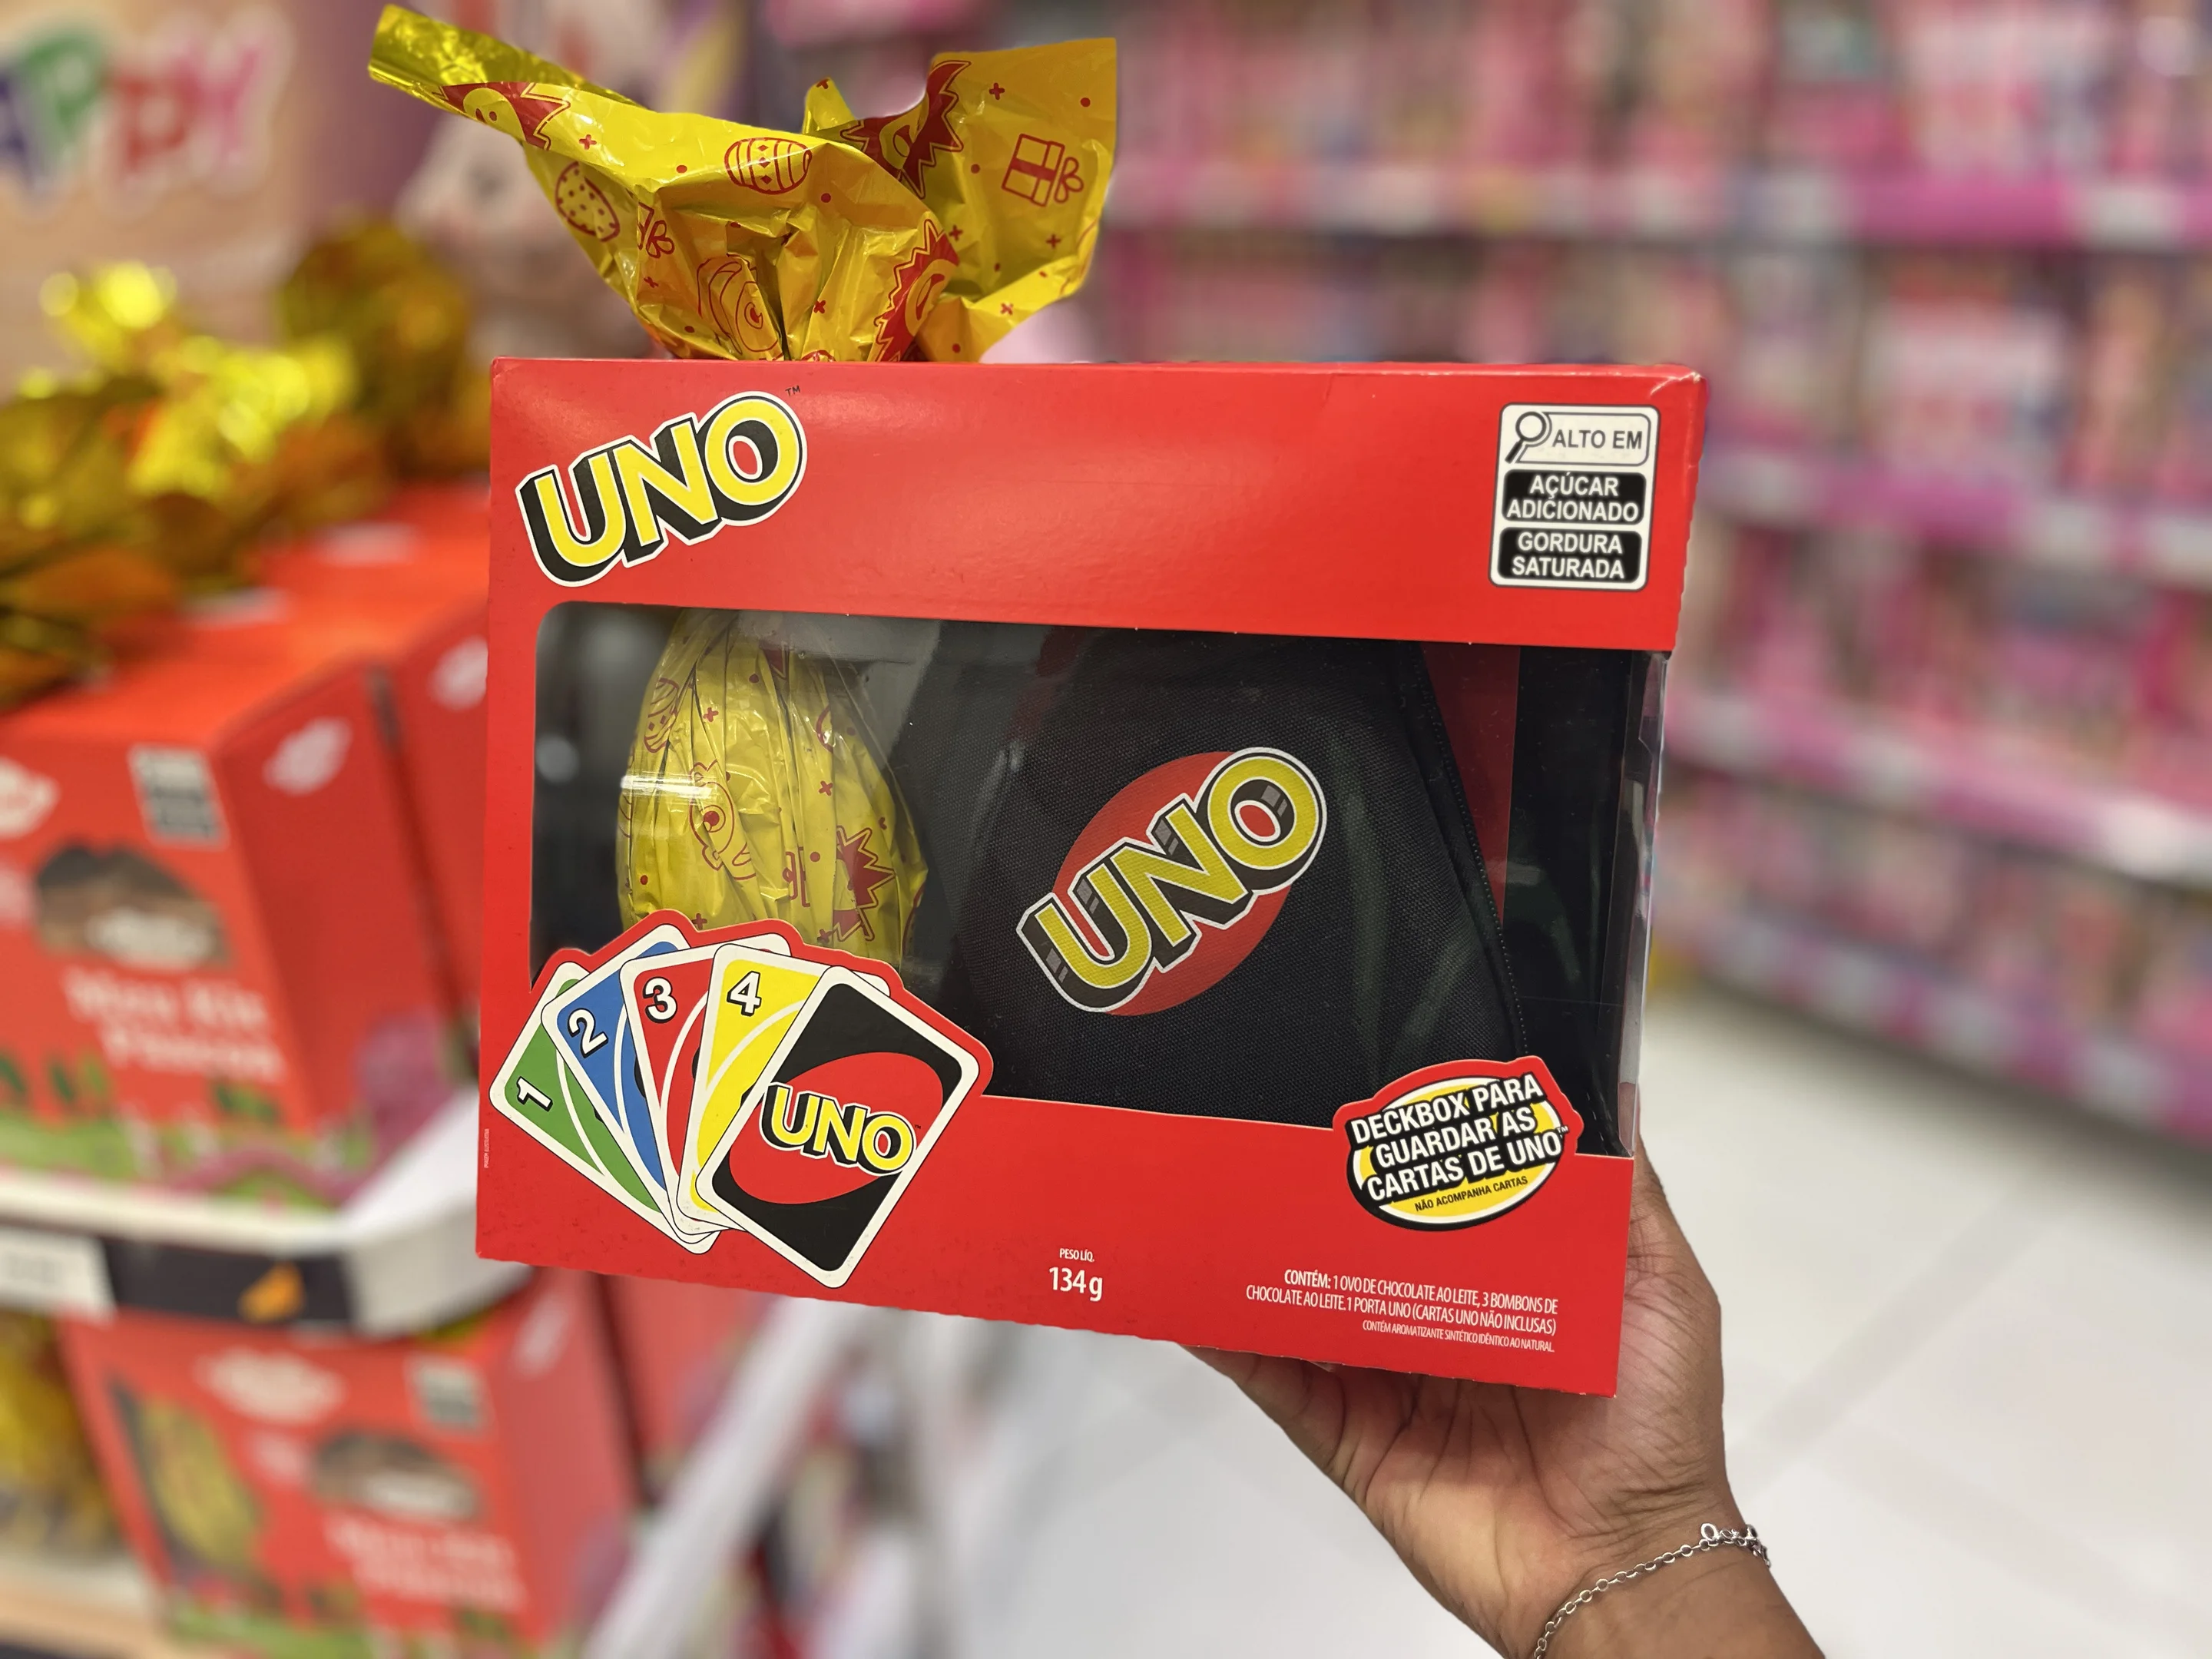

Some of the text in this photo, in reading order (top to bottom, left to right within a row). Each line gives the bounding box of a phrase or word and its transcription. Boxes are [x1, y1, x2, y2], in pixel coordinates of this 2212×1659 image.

[1551, 429, 1643, 450] ALTO EM
[515, 391, 807, 587] UNO
[1529, 472, 1619, 499] AÇÚCAR
[1506, 499, 1639, 522] ADICIONADO
[1518, 531, 1623, 554] GORDURA
[1512, 556, 1624, 579] SATURADA
[1016, 747, 1327, 1013] UNO
[642, 976, 678, 1024] 3
[727, 971, 762, 1017] 4
[567, 1008, 609, 1058] 2
[515, 1076, 554, 1111] 1
[1350, 1074, 1544, 1144] DECKBOX PARA
[759, 1081, 917, 1177] UNO
[1375, 1107, 1536, 1169] GUARDAR AS
[1366, 1154, 1465, 1201] CARTAS
[1467, 1144, 1505, 1176] DE
[1506, 1131, 1561, 1165] UNO
[1415, 1175, 1528, 1212] NÃO ACOMPANHA CARTAS
[1059, 1248, 1080, 1260] PESO
[1246, 1284, 1303, 1306] CHOCOLATE
[1303, 1290, 1319, 1307] AO
[1346, 1296, 1353, 1311] 1
[1353, 1296, 1386, 1315] PORTA
[1388, 1300, 1411, 1318] UNO
[1412, 1303, 1454, 1323] (CARTAS
[1455, 1309, 1479, 1326] UNO
[1479, 1310, 1503, 1329] NÃO
[1503, 1314, 1557, 1336] INCLUSAS)
[1284, 1269, 1558, 1315] CONTÉM: 1 OVO DE CHOCOLATE AO LEITE, 3 BOMBONS DE
[1362, 1320, 1391, 1333] CONTÉM
[1391, 1323, 1444, 1340] AROMATIZANTE
[1444, 1329, 1479, 1343] SINTÉTICO
[1479, 1332, 1510, 1347] IDÊNTICO
[1509, 1337, 1521, 1349] AO
